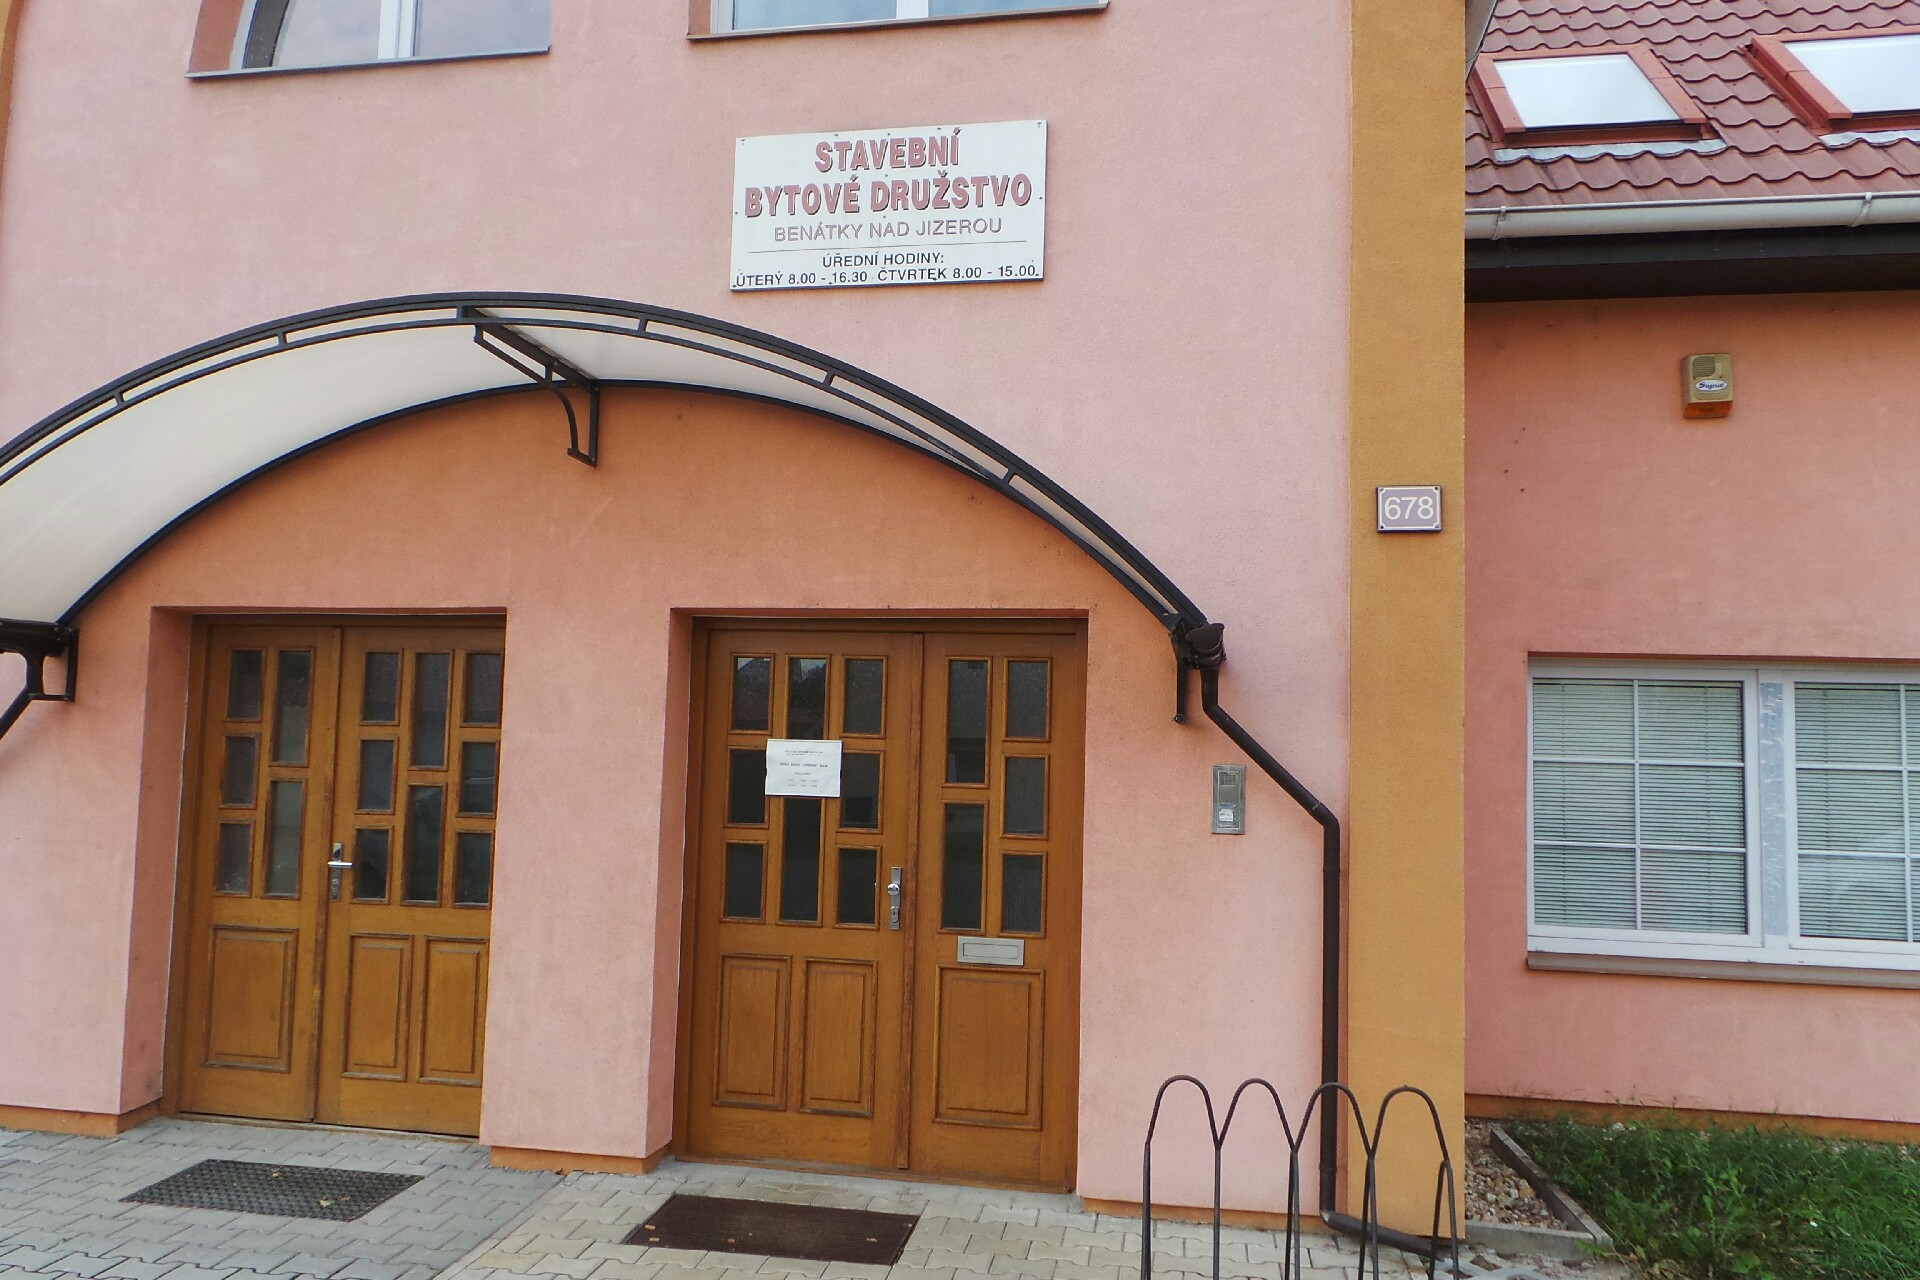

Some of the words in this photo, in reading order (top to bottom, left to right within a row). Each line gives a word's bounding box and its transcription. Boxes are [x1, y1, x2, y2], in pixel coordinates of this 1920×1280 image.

[815, 127, 961, 173] STAVEBNÍ
[745, 174, 861, 218] BYTOVÉ
[870, 170, 1032, 212] DRUŽSTVO
[774, 221, 863, 242] BENÁTKY
[869, 220, 910, 239] NAD
[916, 217, 1003, 237] JIZEROU
[822, 251, 879, 268] ÚŘEDNÍ
[883, 252, 945, 266] HODINY:
[736, 270, 784, 287] ÚTERÝ
[788, 272, 816, 285] 8.00
[831, 271, 867, 283] 16.30
[878, 266, 947, 281] ČTVRTEK
[952, 267, 982, 279] 8.00
[1384, 496, 1434, 520] 678
